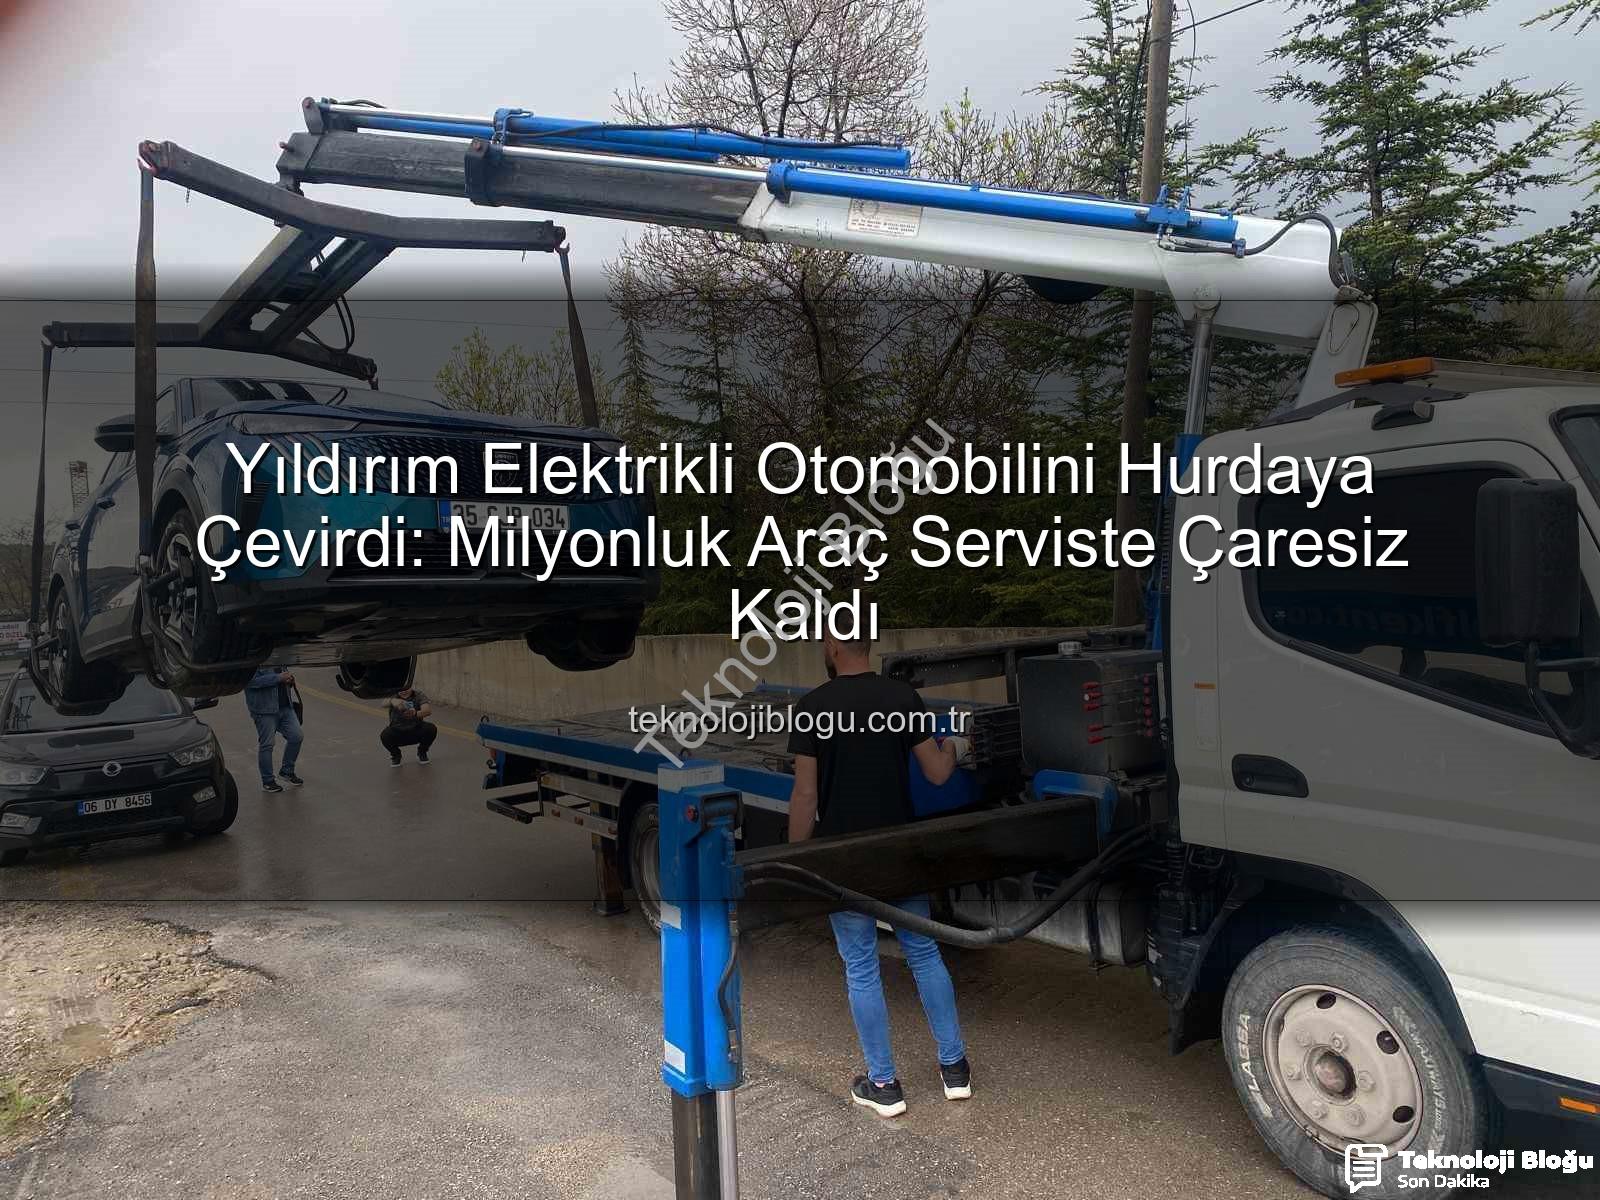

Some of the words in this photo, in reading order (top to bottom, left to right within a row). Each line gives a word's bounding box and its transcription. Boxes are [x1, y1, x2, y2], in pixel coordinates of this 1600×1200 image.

[532, 507, 566, 528] 034
[84, 801, 98, 813] 06
[104, 798, 118, 810] DY
[125, 794, 151, 808] 8456
